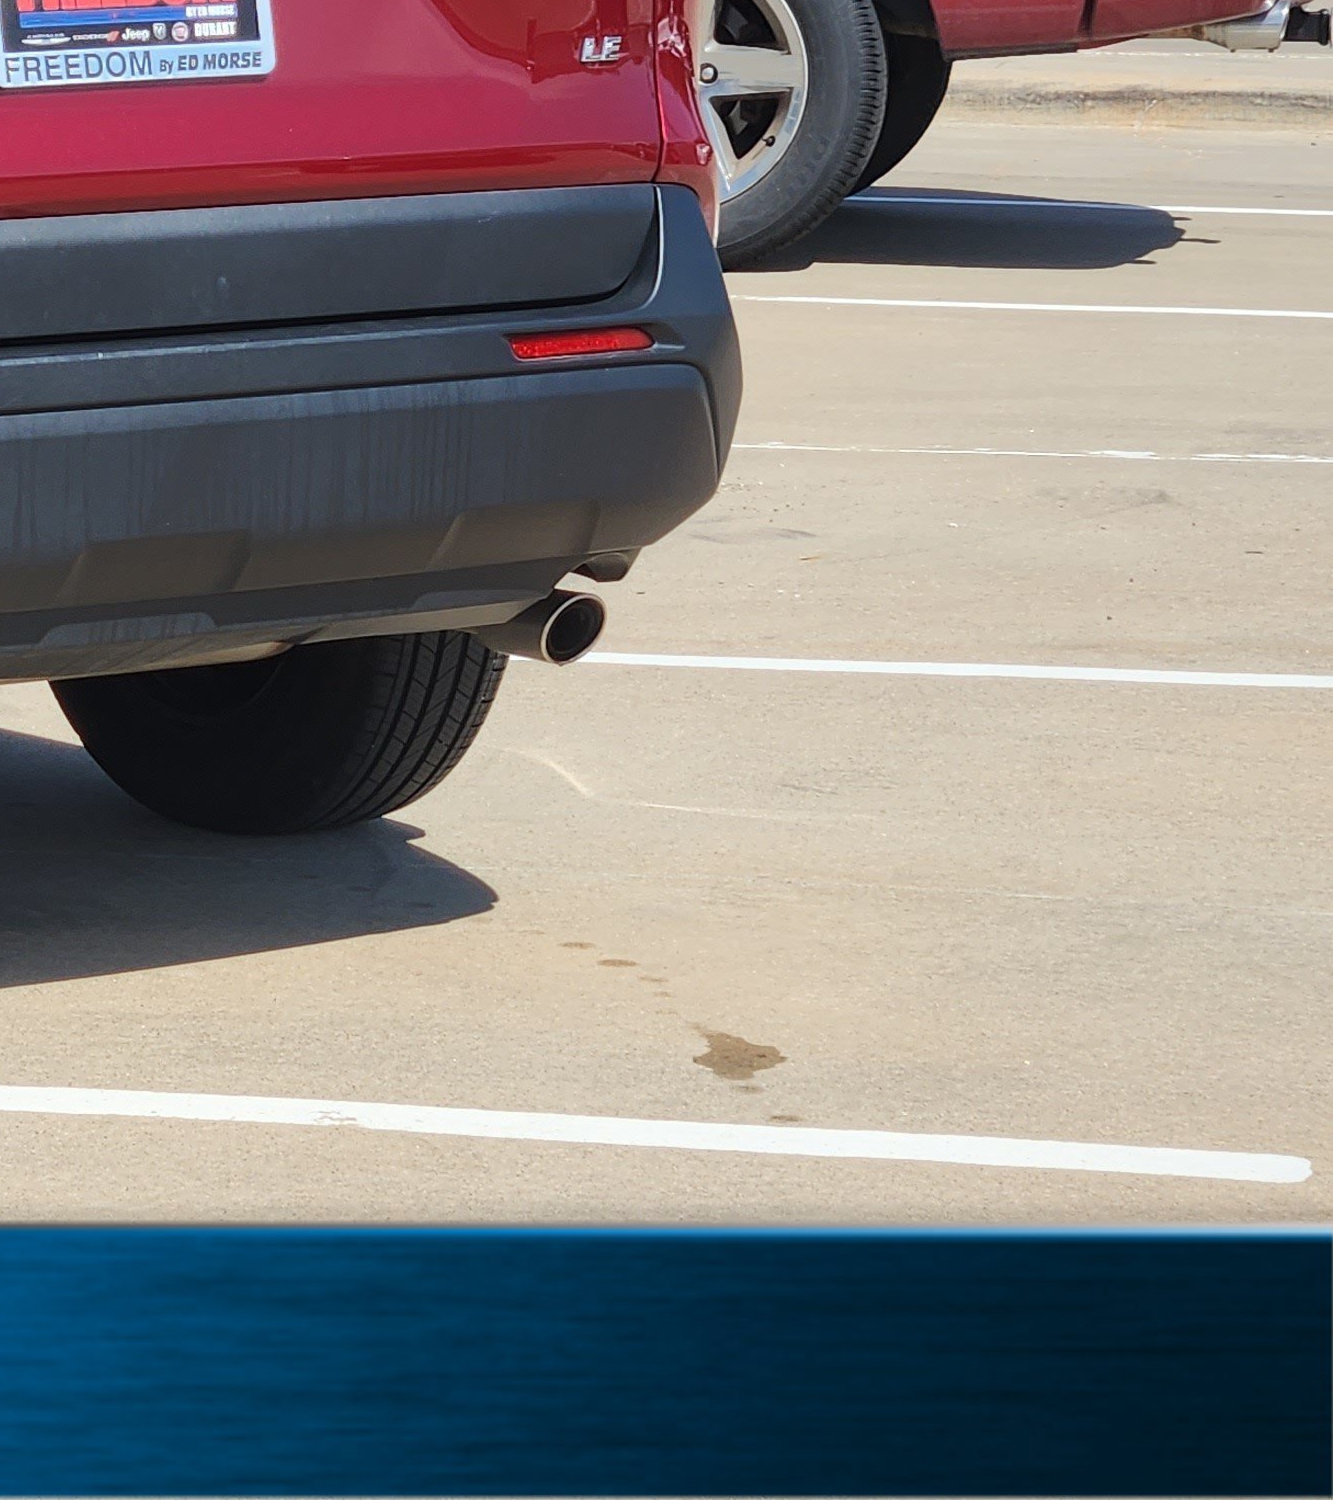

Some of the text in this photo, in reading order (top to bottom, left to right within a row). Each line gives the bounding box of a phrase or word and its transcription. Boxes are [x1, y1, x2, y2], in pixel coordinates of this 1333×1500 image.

[121, 27, 150, 41] Jeep
[580, 35, 623, 62] LE
[4, 50, 153, 83] FREEDOM
[177, 54, 199, 72] ED
[202, 51, 262, 71] MORSE
